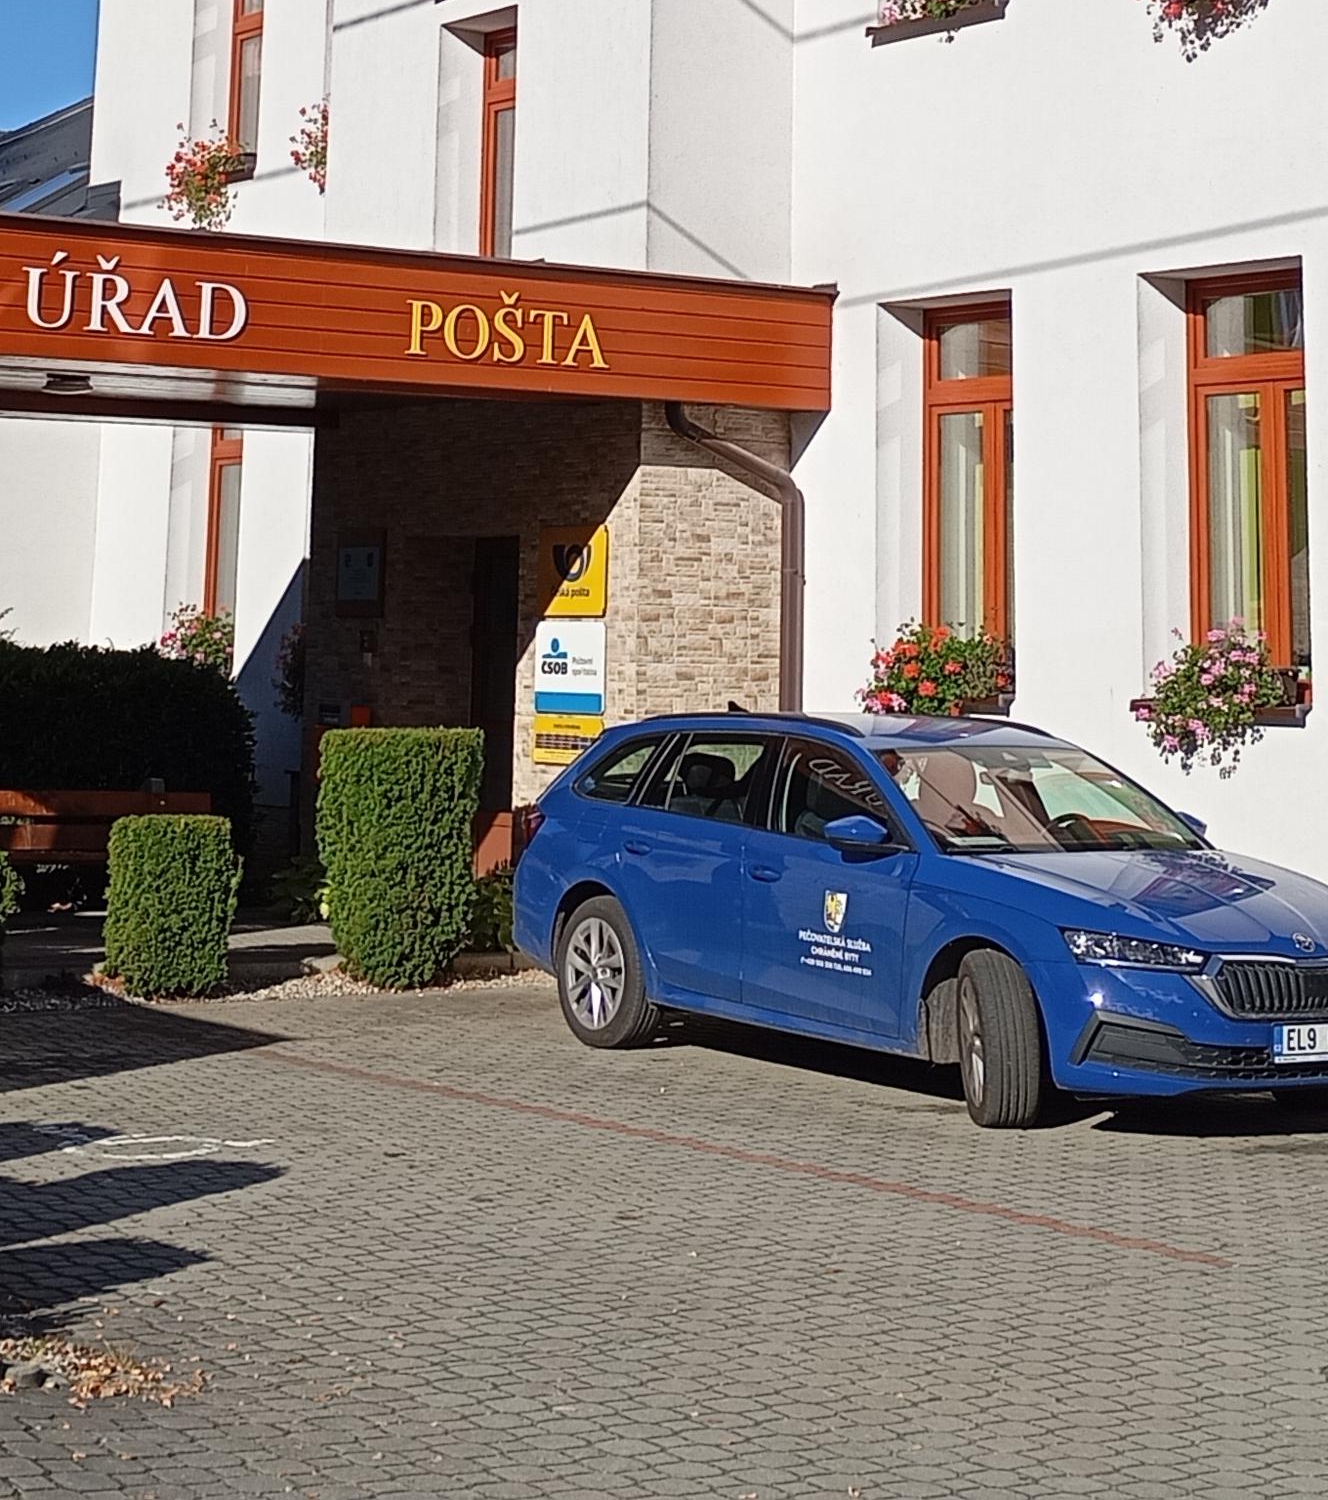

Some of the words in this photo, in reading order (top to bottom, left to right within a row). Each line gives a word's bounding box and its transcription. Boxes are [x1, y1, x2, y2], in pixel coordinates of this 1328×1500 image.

[22, 251, 248, 340] ÚŘAD
[404, 290, 610, 369] POŠTA
[1287, 1027, 1317, 1051] EL9
